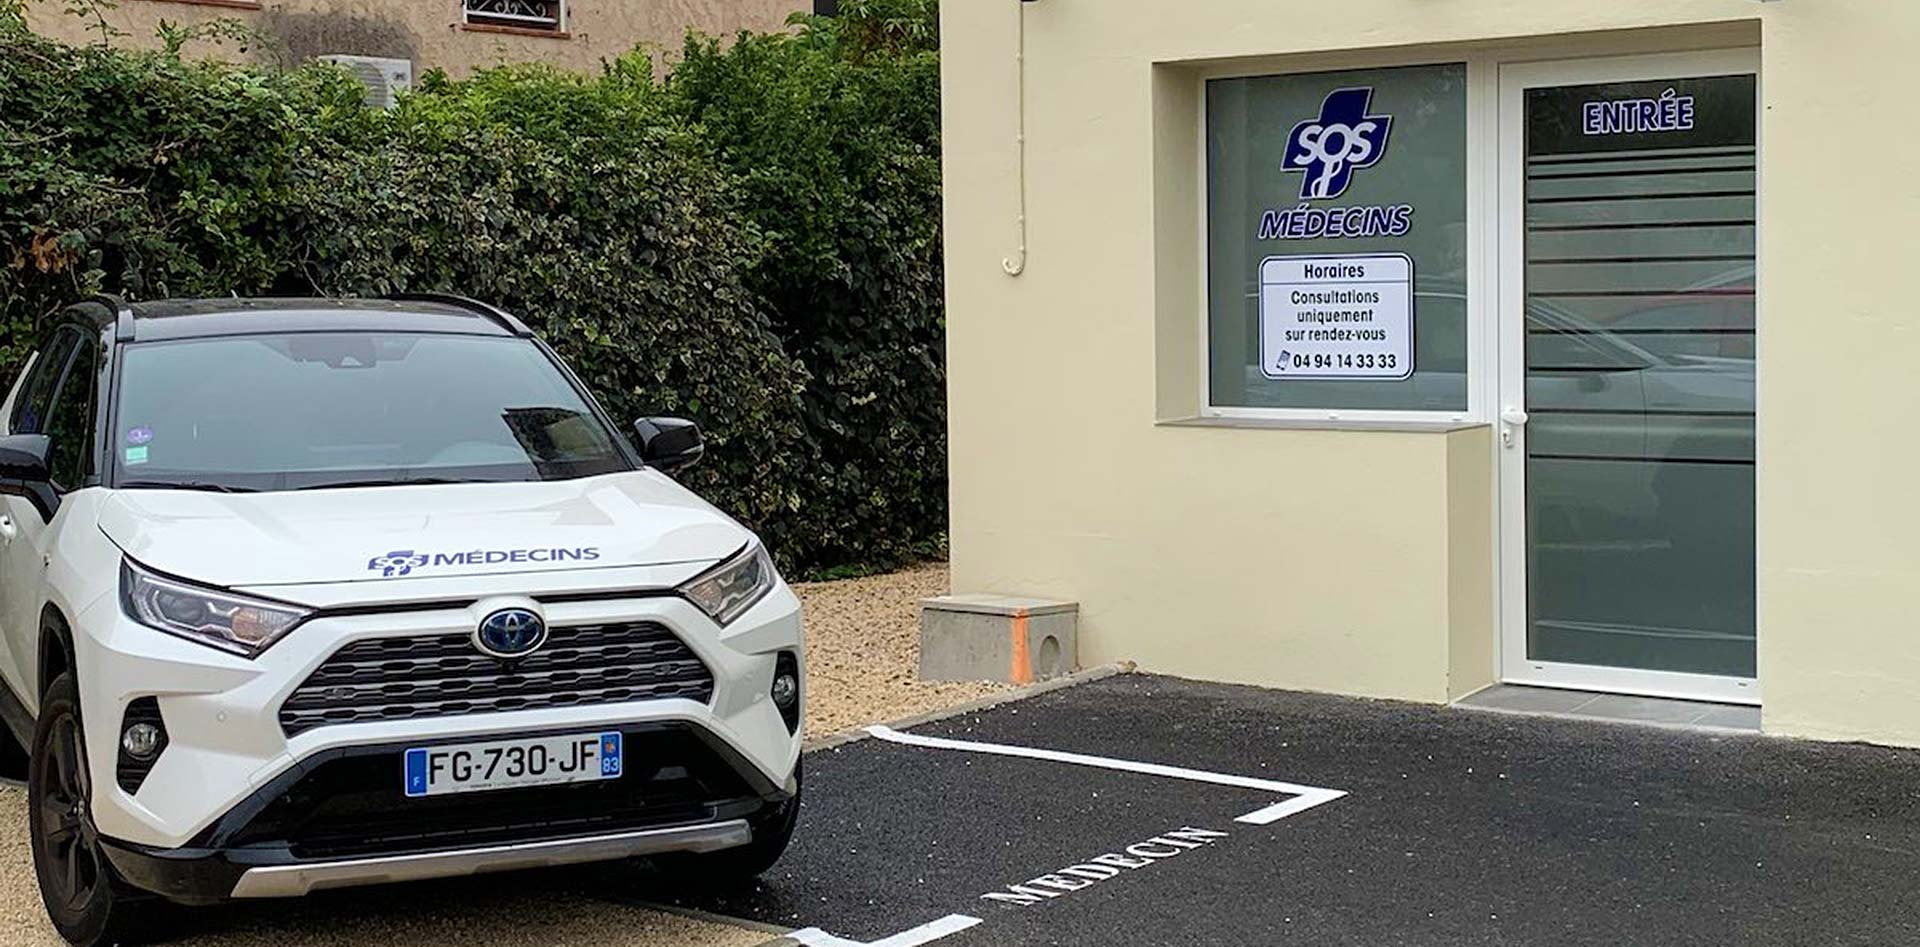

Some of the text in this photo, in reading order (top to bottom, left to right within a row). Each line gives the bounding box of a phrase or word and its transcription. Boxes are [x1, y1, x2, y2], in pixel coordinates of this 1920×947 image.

[1584, 88, 1694, 134] ENTRÉE
[1293, 122, 1377, 165] SOS
[1258, 202, 1414, 239] MÉDECINS
[1304, 263, 1365, 279] Horaires
[1290, 289, 1380, 304] Consultations
[1297, 309, 1373, 325] uniquement
[1285, 328, 1386, 341] sur rendez-vous
[1293, 354, 1396, 368] 04 94 14 33 33
[433, 548, 600, 566] MÉDECINS
[413, 776, 420, 787] F
[429, 740, 599, 784] FG-730-JF
[602, 757, 619, 773] 83
[979, 826, 1230, 905] MEDECIN
